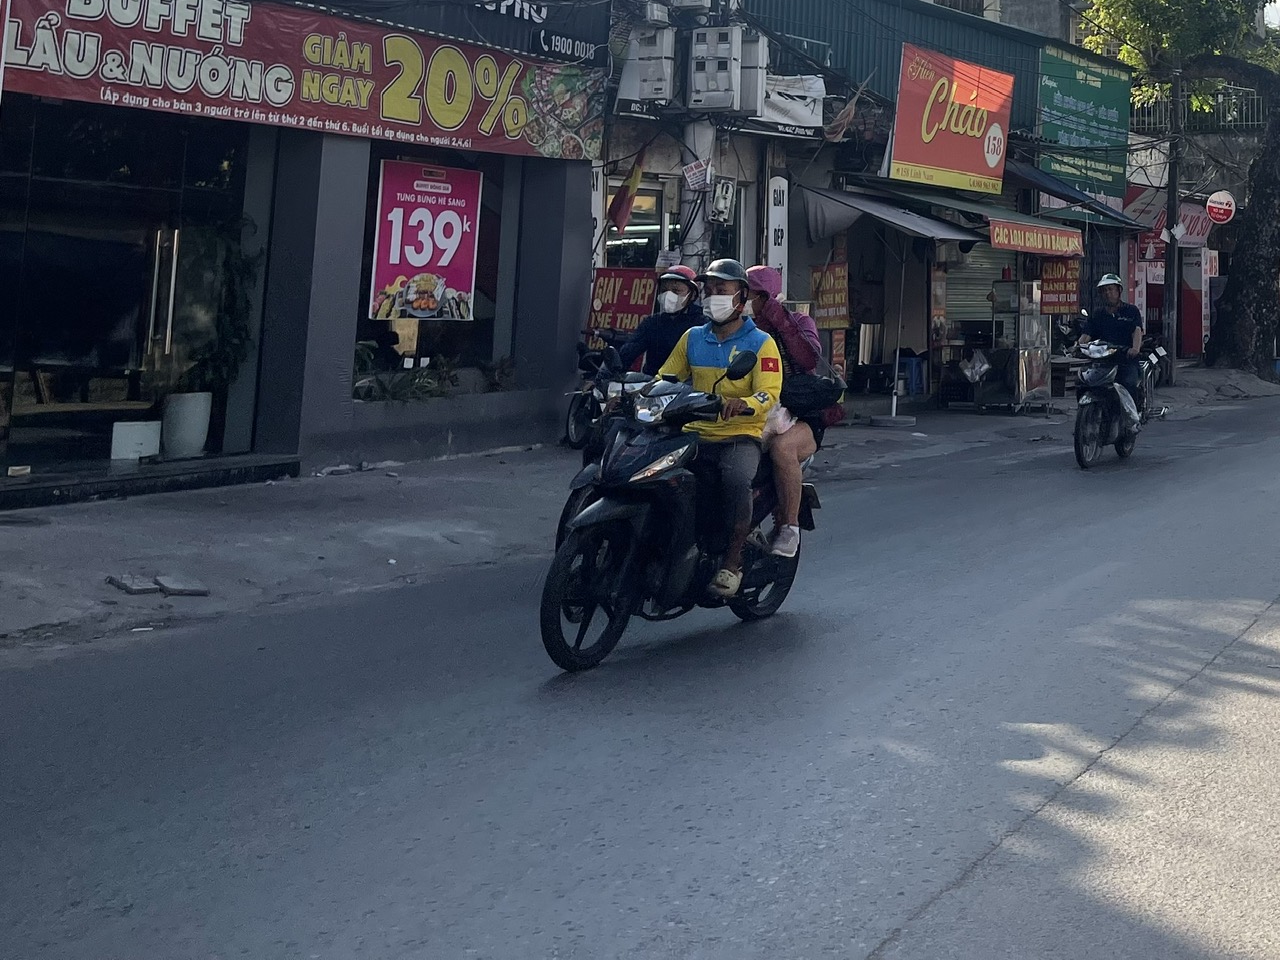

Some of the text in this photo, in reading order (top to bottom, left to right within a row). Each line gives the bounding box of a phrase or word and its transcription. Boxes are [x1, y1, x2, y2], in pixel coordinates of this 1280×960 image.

[4, 11, 102, 79] LẨU
[128, 40, 295, 107] NƯỚNG
[302, 30, 374, 76] GIẢM
[551, 34, 573, 55] 1900
[300, 69, 376, 112] NGAY
[380, 32, 530, 141] 20%
[122, 90, 150, 107] dụng
[152, 96, 171, 109] cho
[203, 105, 232, 117] người
[251, 109, 266, 121] lên
[281, 113, 298, 125] thứ
[307, 116, 323, 129] đến
[325, 118, 340, 131] thứ
[416, 132, 429, 143] cho
[921, 76, 989, 144] Cháo
[986, 134, 1003, 157] 158
[447, 197, 466, 208] SANG
[630, 272, 655, 305] DÉP
